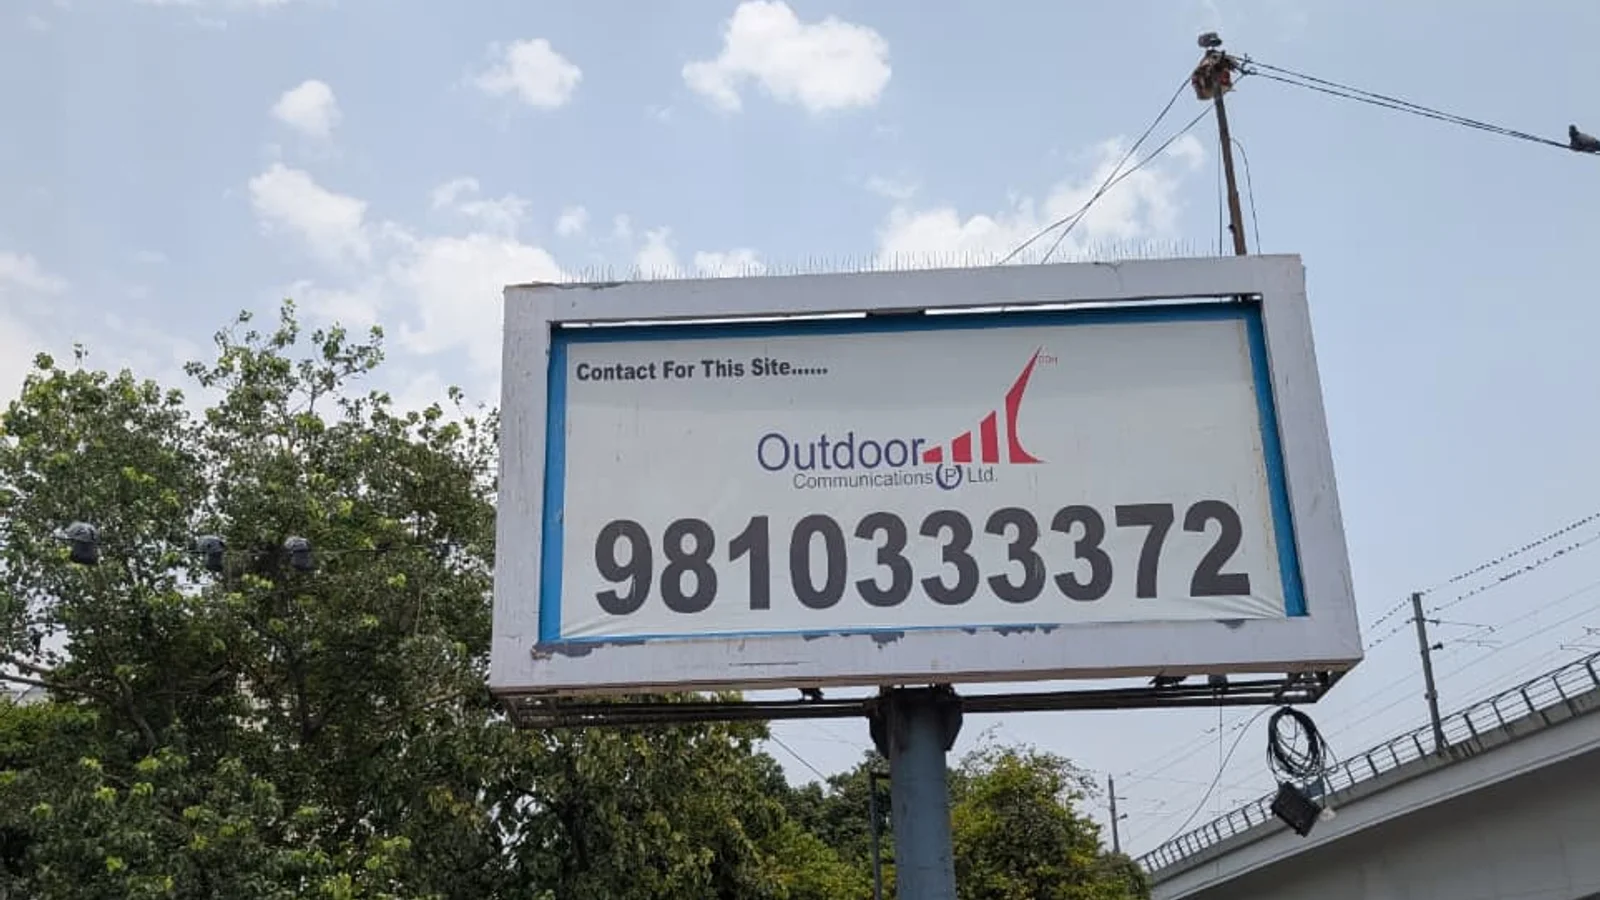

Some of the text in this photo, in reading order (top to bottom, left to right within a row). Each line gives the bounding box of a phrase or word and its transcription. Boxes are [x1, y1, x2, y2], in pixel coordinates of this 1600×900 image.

[576, 363, 657, 381] Contact
[662, 360, 696, 379] For
[700, 358, 745, 378] This
[757, 432, 925, 472] Outdoor
[793, 470, 933, 490] Communications
[967, 466, 998, 484] Ltd.
[595, 500, 1250, 614] 9810333372
